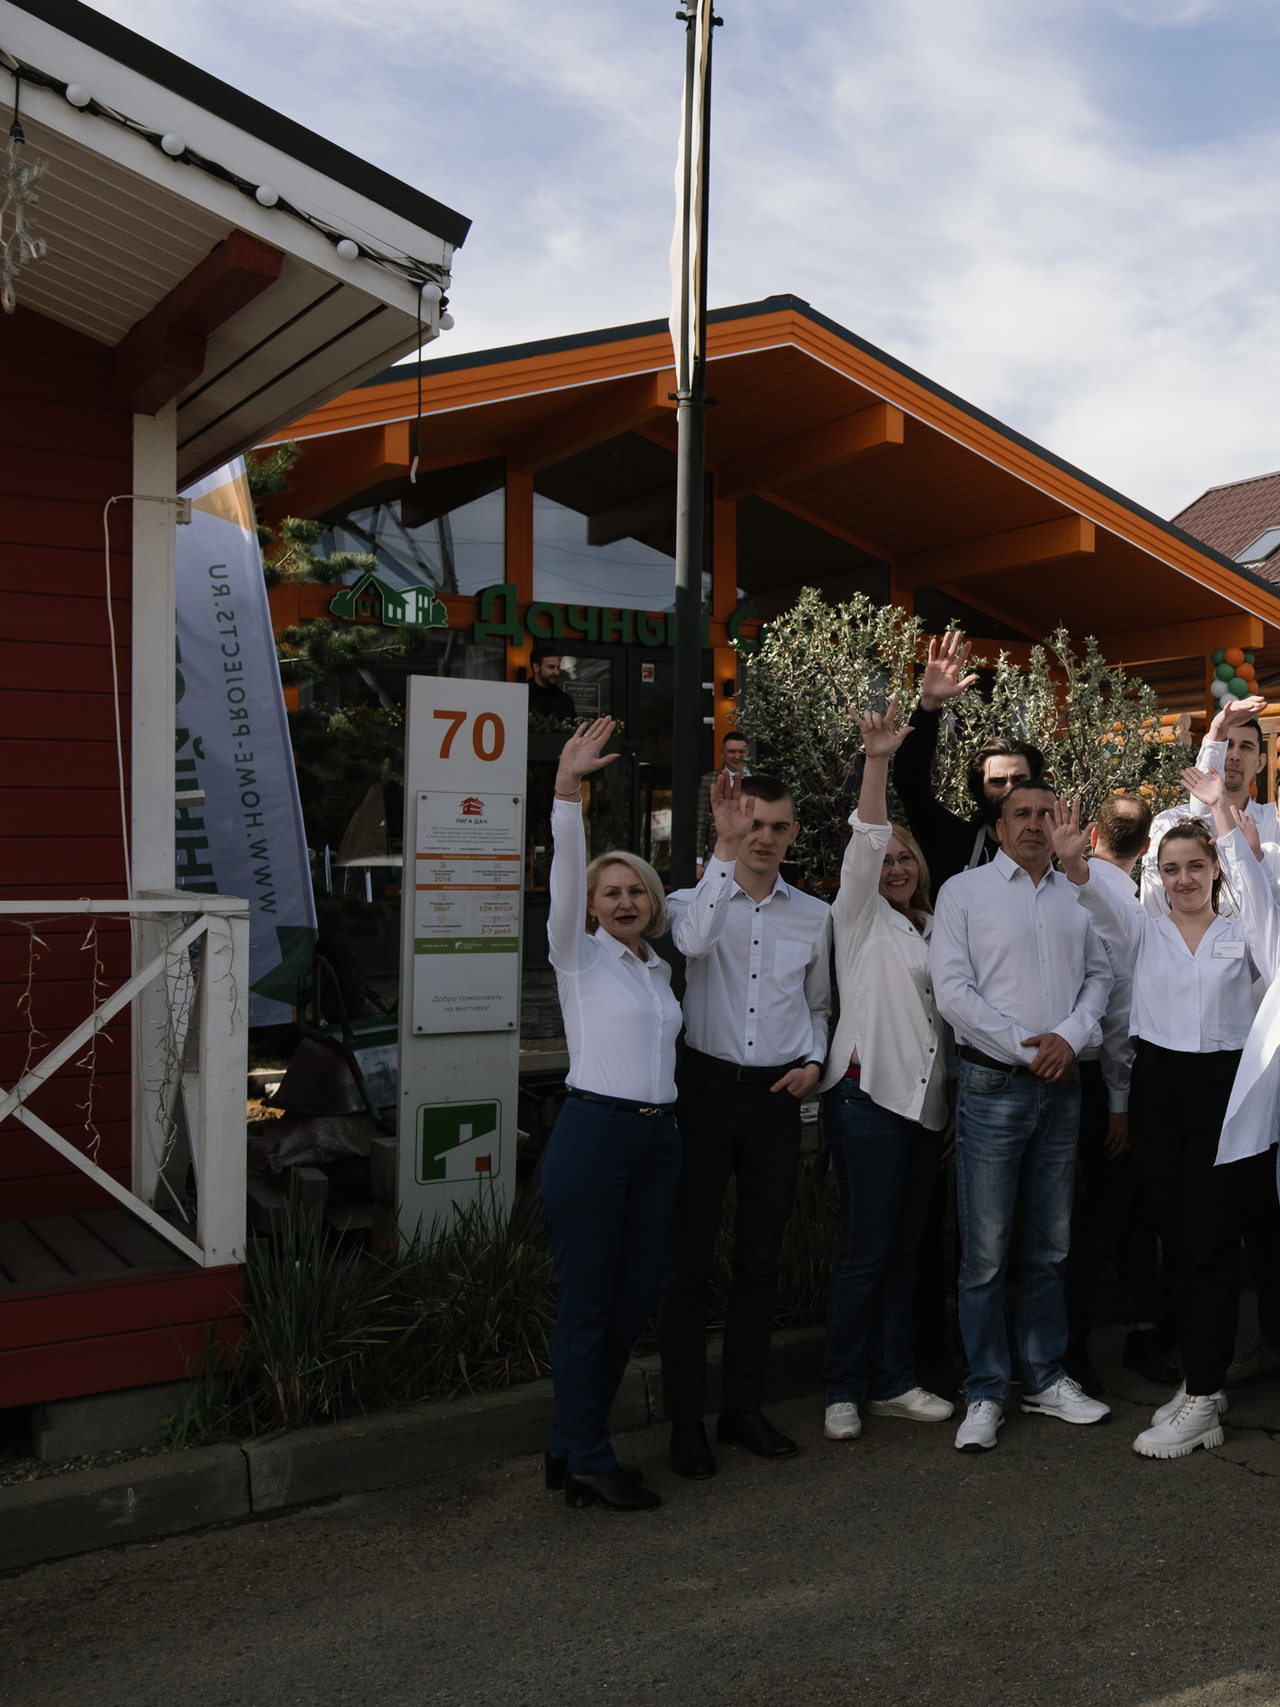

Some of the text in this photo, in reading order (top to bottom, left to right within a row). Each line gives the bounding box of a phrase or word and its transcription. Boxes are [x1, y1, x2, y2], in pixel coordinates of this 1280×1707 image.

[474, 584, 710, 649] Дачны
[432, 710, 506, 762] 70
[432, 994, 503, 1003] Добро пожаловать
[455, 1005, 491, 1013] выставку!
